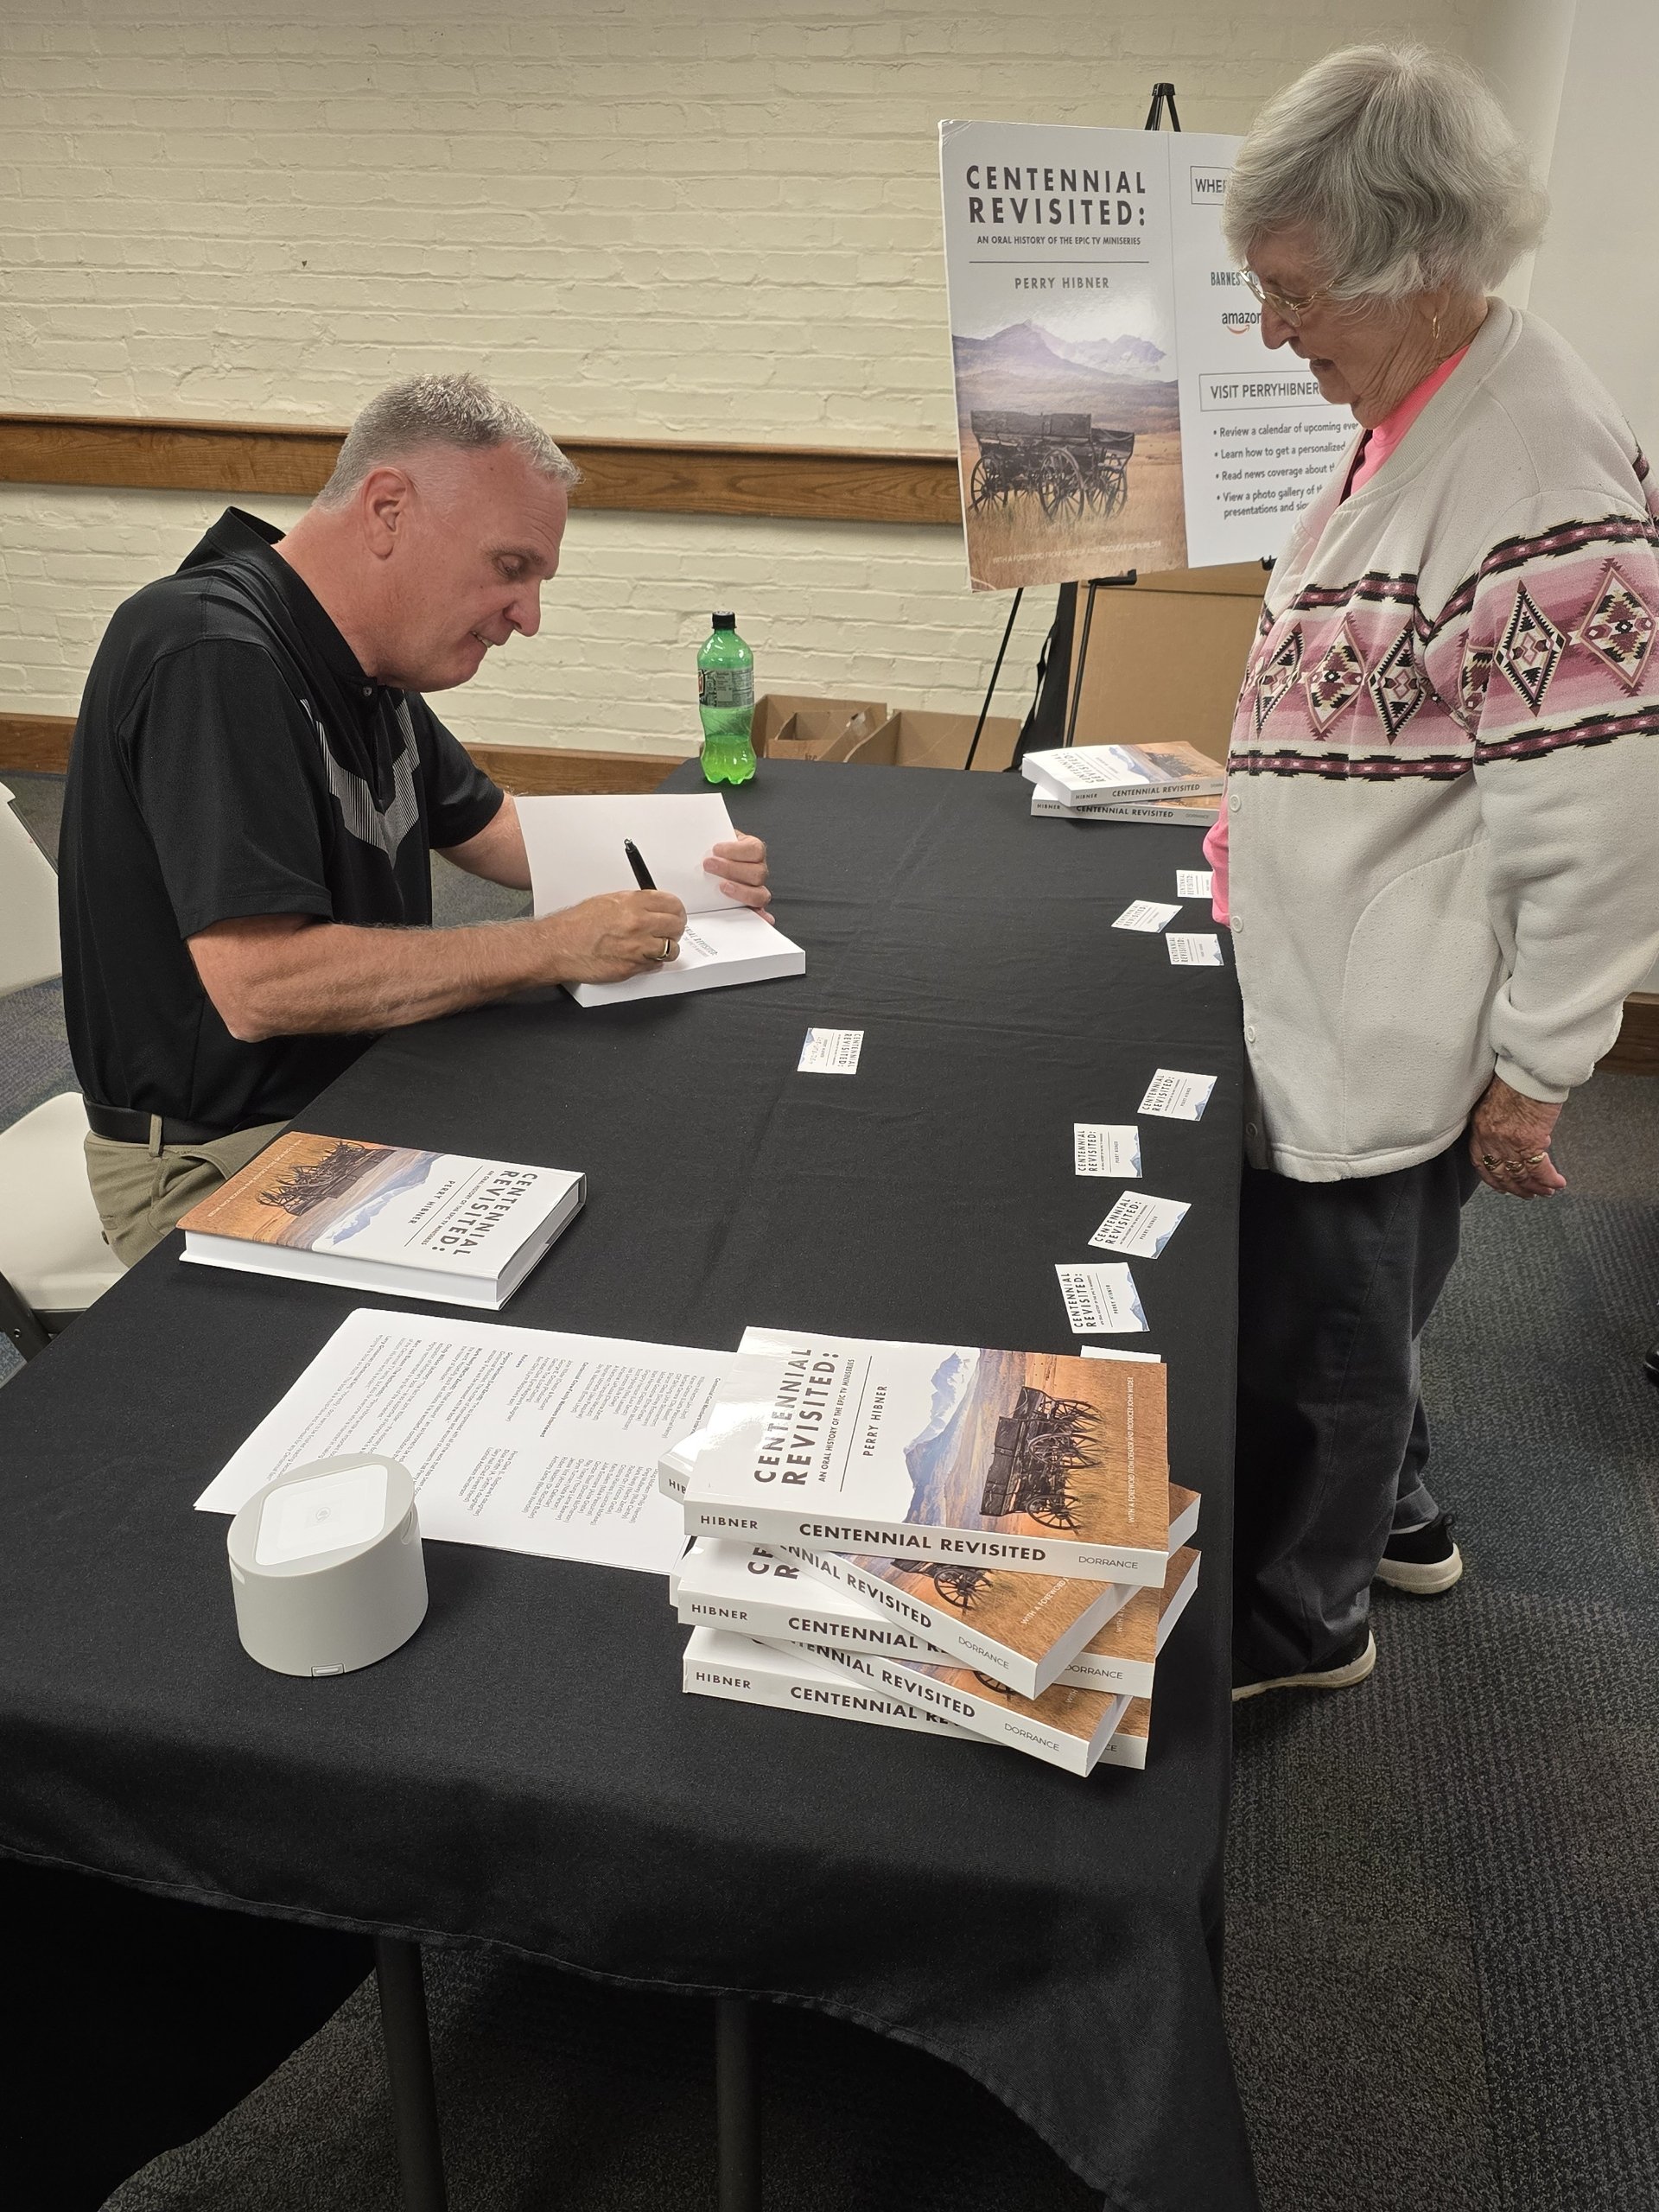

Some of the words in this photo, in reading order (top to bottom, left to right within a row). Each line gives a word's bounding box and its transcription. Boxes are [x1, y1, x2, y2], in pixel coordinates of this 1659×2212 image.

[966, 165, 1146, 194] CENTENNIAL
[1195, 179, 1226, 193] WHE
[969, 196, 1144, 226] REVISITED:
[977, 236, 988, 245] AN
[991, 236, 1012, 245] ORAL
[1014, 236, 1046, 245] HISTORY
[1092, 237, 1101, 245] TV
[1103, 237, 1141, 245] MINISERIES
[1014, 277, 1056, 289] PERRY
[1062, 277, 1109, 289] HIBNER
[1211, 272, 1241, 286] BARNES
[1211, 385, 1239, 399] VISIT
[1220, 427, 1249, 437] Review
[1258, 424, 1292, 435] calendar
[1295, 423, 1303, 433] of
[1304, 422, 1341, 434] upcoming
[1221, 448, 1243, 460] Learn
[1245, 447, 1262, 458] how
[1265, 447, 1274, 456] to
[1275, 446, 1289, 459] get
[1222, 470, 1242, 480] Read
[1244, 469, 1265, 480] news
[1267, 467, 1303, 479] coverage
[1305, 464, 1327, 474] about
[1223, 491, 1243, 502] View
[1245, 492, 1250, 500] a
[1252, 488, 1275, 502] photo
[1278, 486, 1305, 499] gallery
[1306, 485, 1315, 495] of
[1224, 504, 1278, 519] presentations
[1280, 501, 1294, 512] and
[1112, 786, 1160, 798] CENTENNIAL
[1162, 784, 1200, 794] REVISITED
[1076, 805, 1128, 815] CENTENNIAL
[1132, 809, 1174, 818] REVISITED
[1142, 1076, 1164, 1109] CENTENNIAL
[1152, 1077, 1173, 1111] REVISITED:
[1077, 1131, 1086, 1171] CENTENNIAL
[1088, 1132, 1097, 1171] REVISITED:
[434, 1180, 455, 1198] PERRY
[408, 1202, 435, 1224] HIBNER
[433, 1171, 518, 1250] REVISITED:
[454, 1173, 537, 1254] CENTENNIAL
[1095, 1199, 1129, 1241] CENTENNIAL
[1105, 1202, 1141, 1243] REVISITED:
[1061, 1274, 1083, 1327] CENTENNIAL
[1074, 1274, 1096, 1326] REVISITED:
[842, 1359, 855, 1386] MINISERIES
[834, 1407, 842, 1416] THE
[836, 1395, 846, 1405] EPIC
[753, 1348, 812, 1484] CENTENNIAL
[780, 1351, 839, 1487] REVISITED:
[863, 1426, 878, 1456] PERRY
[871, 1386, 887, 1420] HIBNER
[825, 1427, 836, 1451] HISTORY
[821, 1453, 831, 1469] ORAL
[818, 1471, 827, 1482] AN
[1127, 1473, 1135, 1502] FOREWORD
[700, 1515, 758, 1529] HIBNER
[799, 1523, 931, 1549] CENTENNIAL
[940, 1539, 1046, 1561] REVISITED
[1078, 1555, 1139, 1569] DORRANCE
[1020, 1610, 1037, 1625] WITH
[1035, 1603, 1040, 1611] A
[1038, 1580, 1066, 1610] FOREWORD
[847, 1573, 932, 1629] REVISITED
[958, 1636, 1010, 1670] DORRANCE
[691, 1604, 748, 1621] HIBNER
[788, 1617, 918, 1649] CENTENNIAL
[1065, 1664, 1123, 1680] DORRANCE
[696, 1671, 751, 1689] HIBNER
[791, 1686, 918, 1719] CENTENNIAL
[1065, 1688, 1078, 1704] WITH
[882, 1669, 976, 1718] REVISITED
[1004, 1722, 1060, 1752] DORRANCE
